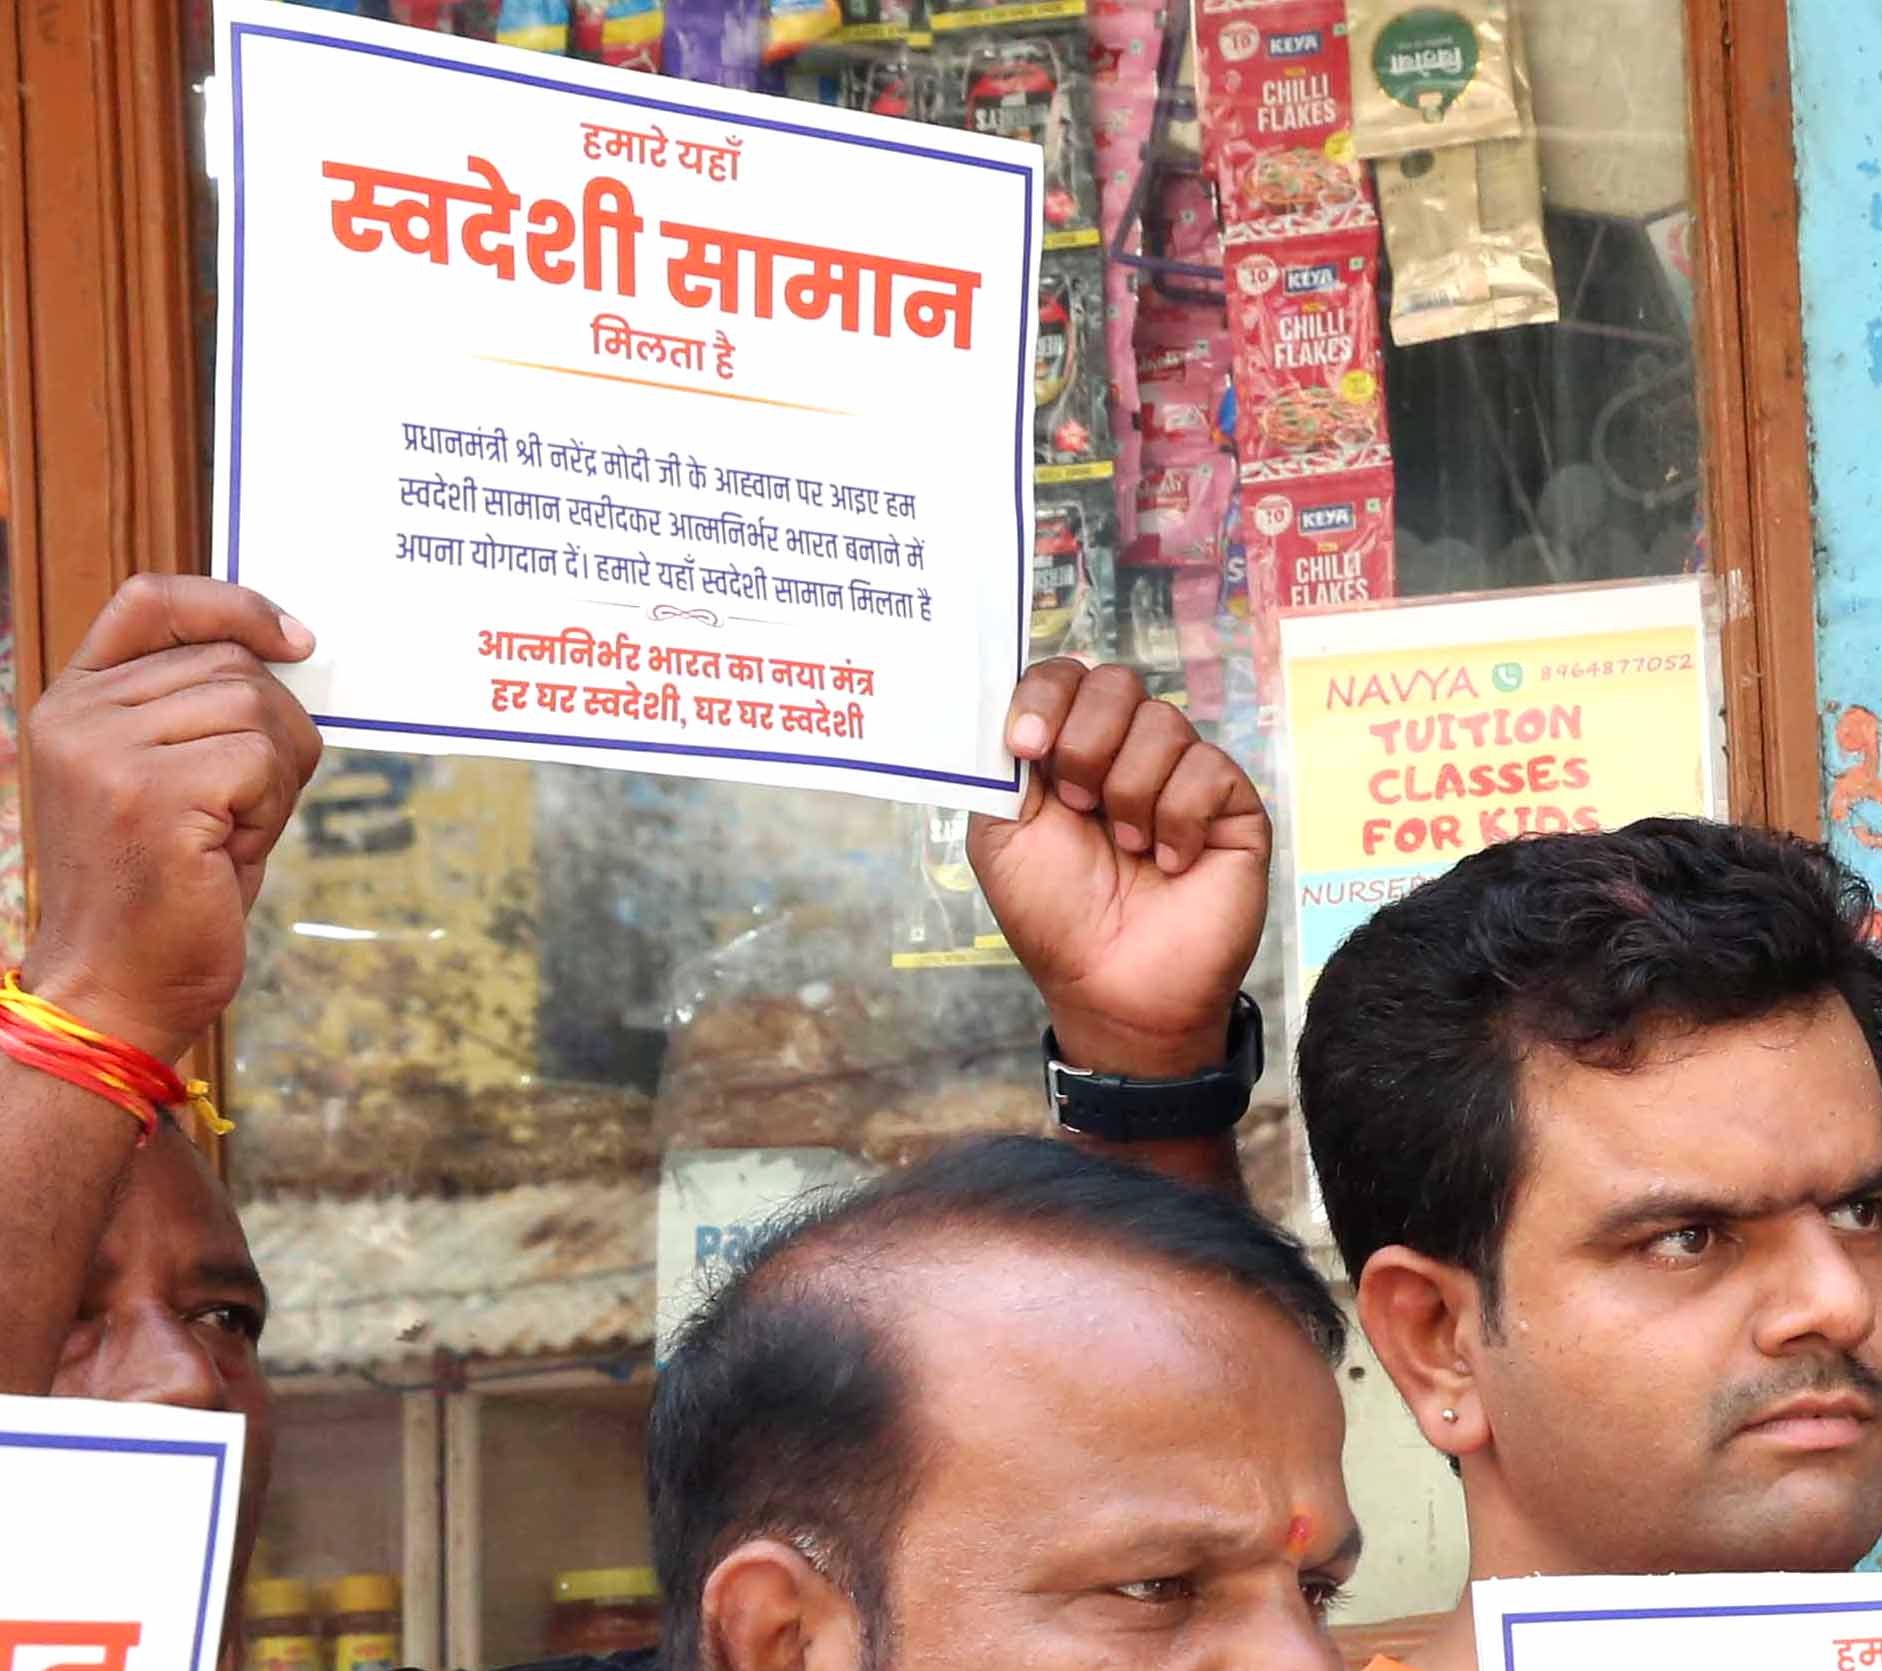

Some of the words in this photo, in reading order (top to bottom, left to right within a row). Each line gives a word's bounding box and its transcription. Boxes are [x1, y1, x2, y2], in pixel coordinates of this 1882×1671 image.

[1270, 35, 1318, 54] KEYA
[1263, 74, 1329, 105] CHILLI
[1257, 98, 1336, 133] FLAKES
[579, 122, 670, 169] हमारे
[674, 134, 744, 183] यहाँ
[321, 154, 645, 299] स्वदेशी
[658, 219, 983, 351] सामान
[1288, 269, 1334, 290] KEYA
[589, 312, 707, 372] मिलता
[712, 329, 737, 381] है
[1280, 309, 1344, 340] CHILLI
[1275, 338, 1352, 368] FLAKES
[401, 422, 509, 464] प्रधानमंत्री
[515, 431, 544, 468] श्री
[547, 437, 598, 477] नरेंद्र
[601, 444, 651, 483] मोदी
[654, 451, 683, 488] जी
[685, 455, 708, 491] के
[795, 478, 824, 508] पर
[829, 483, 880, 515] आइए
[882, 491, 916, 521] हम
[398, 472, 479, 513] स्वदेशी
[481, 487, 562, 523] सामान
[565, 493, 662, 537] खरीदकर
[668, 511, 780, 553] आत्मनिर्भर
[785, 527, 839, 560] भारत
[842, 533, 901, 568] बनाने
[904, 536, 926, 571] में
[1302, 507, 1350, 529] KEYA
[395, 532, 466, 567] अपना
[469, 532, 559, 577] योगदान
[593, 551, 651, 587] हमारे
[655, 553, 696, 592] यहाँ
[698, 562, 768, 601] स्वदेशी
[771, 576, 844, 611] सामान
[847, 578, 914, 619] मिलता
[917, 587, 933, 623] है
[1291, 579, 1368, 606] FLAKES
[1296, 552, 1361, 583] CHILLI
[477, 626, 642, 673] आत्मनिर्भर
[647, 645, 723, 680] भारत
[724, 653, 765, 685] का
[767, 658, 827, 691] नया
[829, 658, 875, 697] मंत्र
[1326, 667, 1479, 710] NAVYA
[1540, 654, 1694, 682] 8964877052
[490, 678, 531, 713] हर
[535, 682, 578, 714] घर
[692, 695, 733, 727] घर
[735, 699, 775, 731] घर
[778, 698, 865, 740] स्वदेशी
[1370, 705, 1583, 756] TUITION
[1369, 755, 1590, 806] CLASSES
[1363, 815, 1462, 857] FOR
[1479, 806, 1602, 848] KIDS
